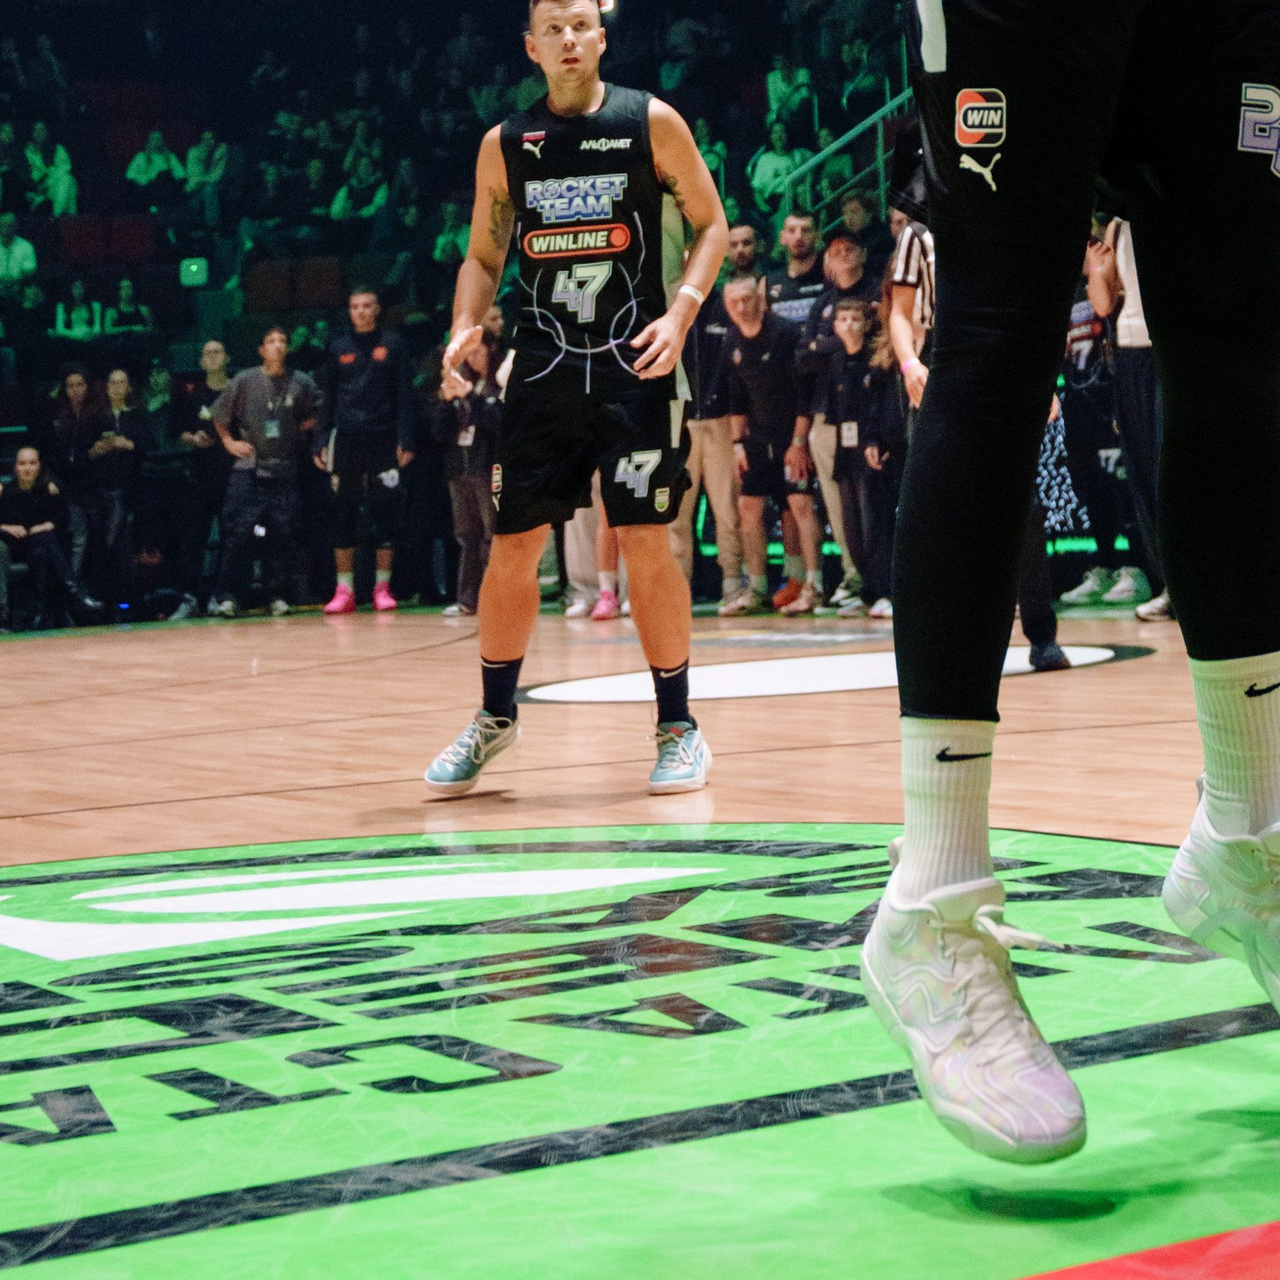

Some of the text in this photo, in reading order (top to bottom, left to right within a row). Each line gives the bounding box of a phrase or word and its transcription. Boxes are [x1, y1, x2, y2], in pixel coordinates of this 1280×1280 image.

[967, 109, 1002, 126] WIN
[537, 194, 613, 224] TEAM
[532, 231, 609, 253] WINLINE
[551, 260, 613, 324] 47
[614, 449, 662, 498] 47
